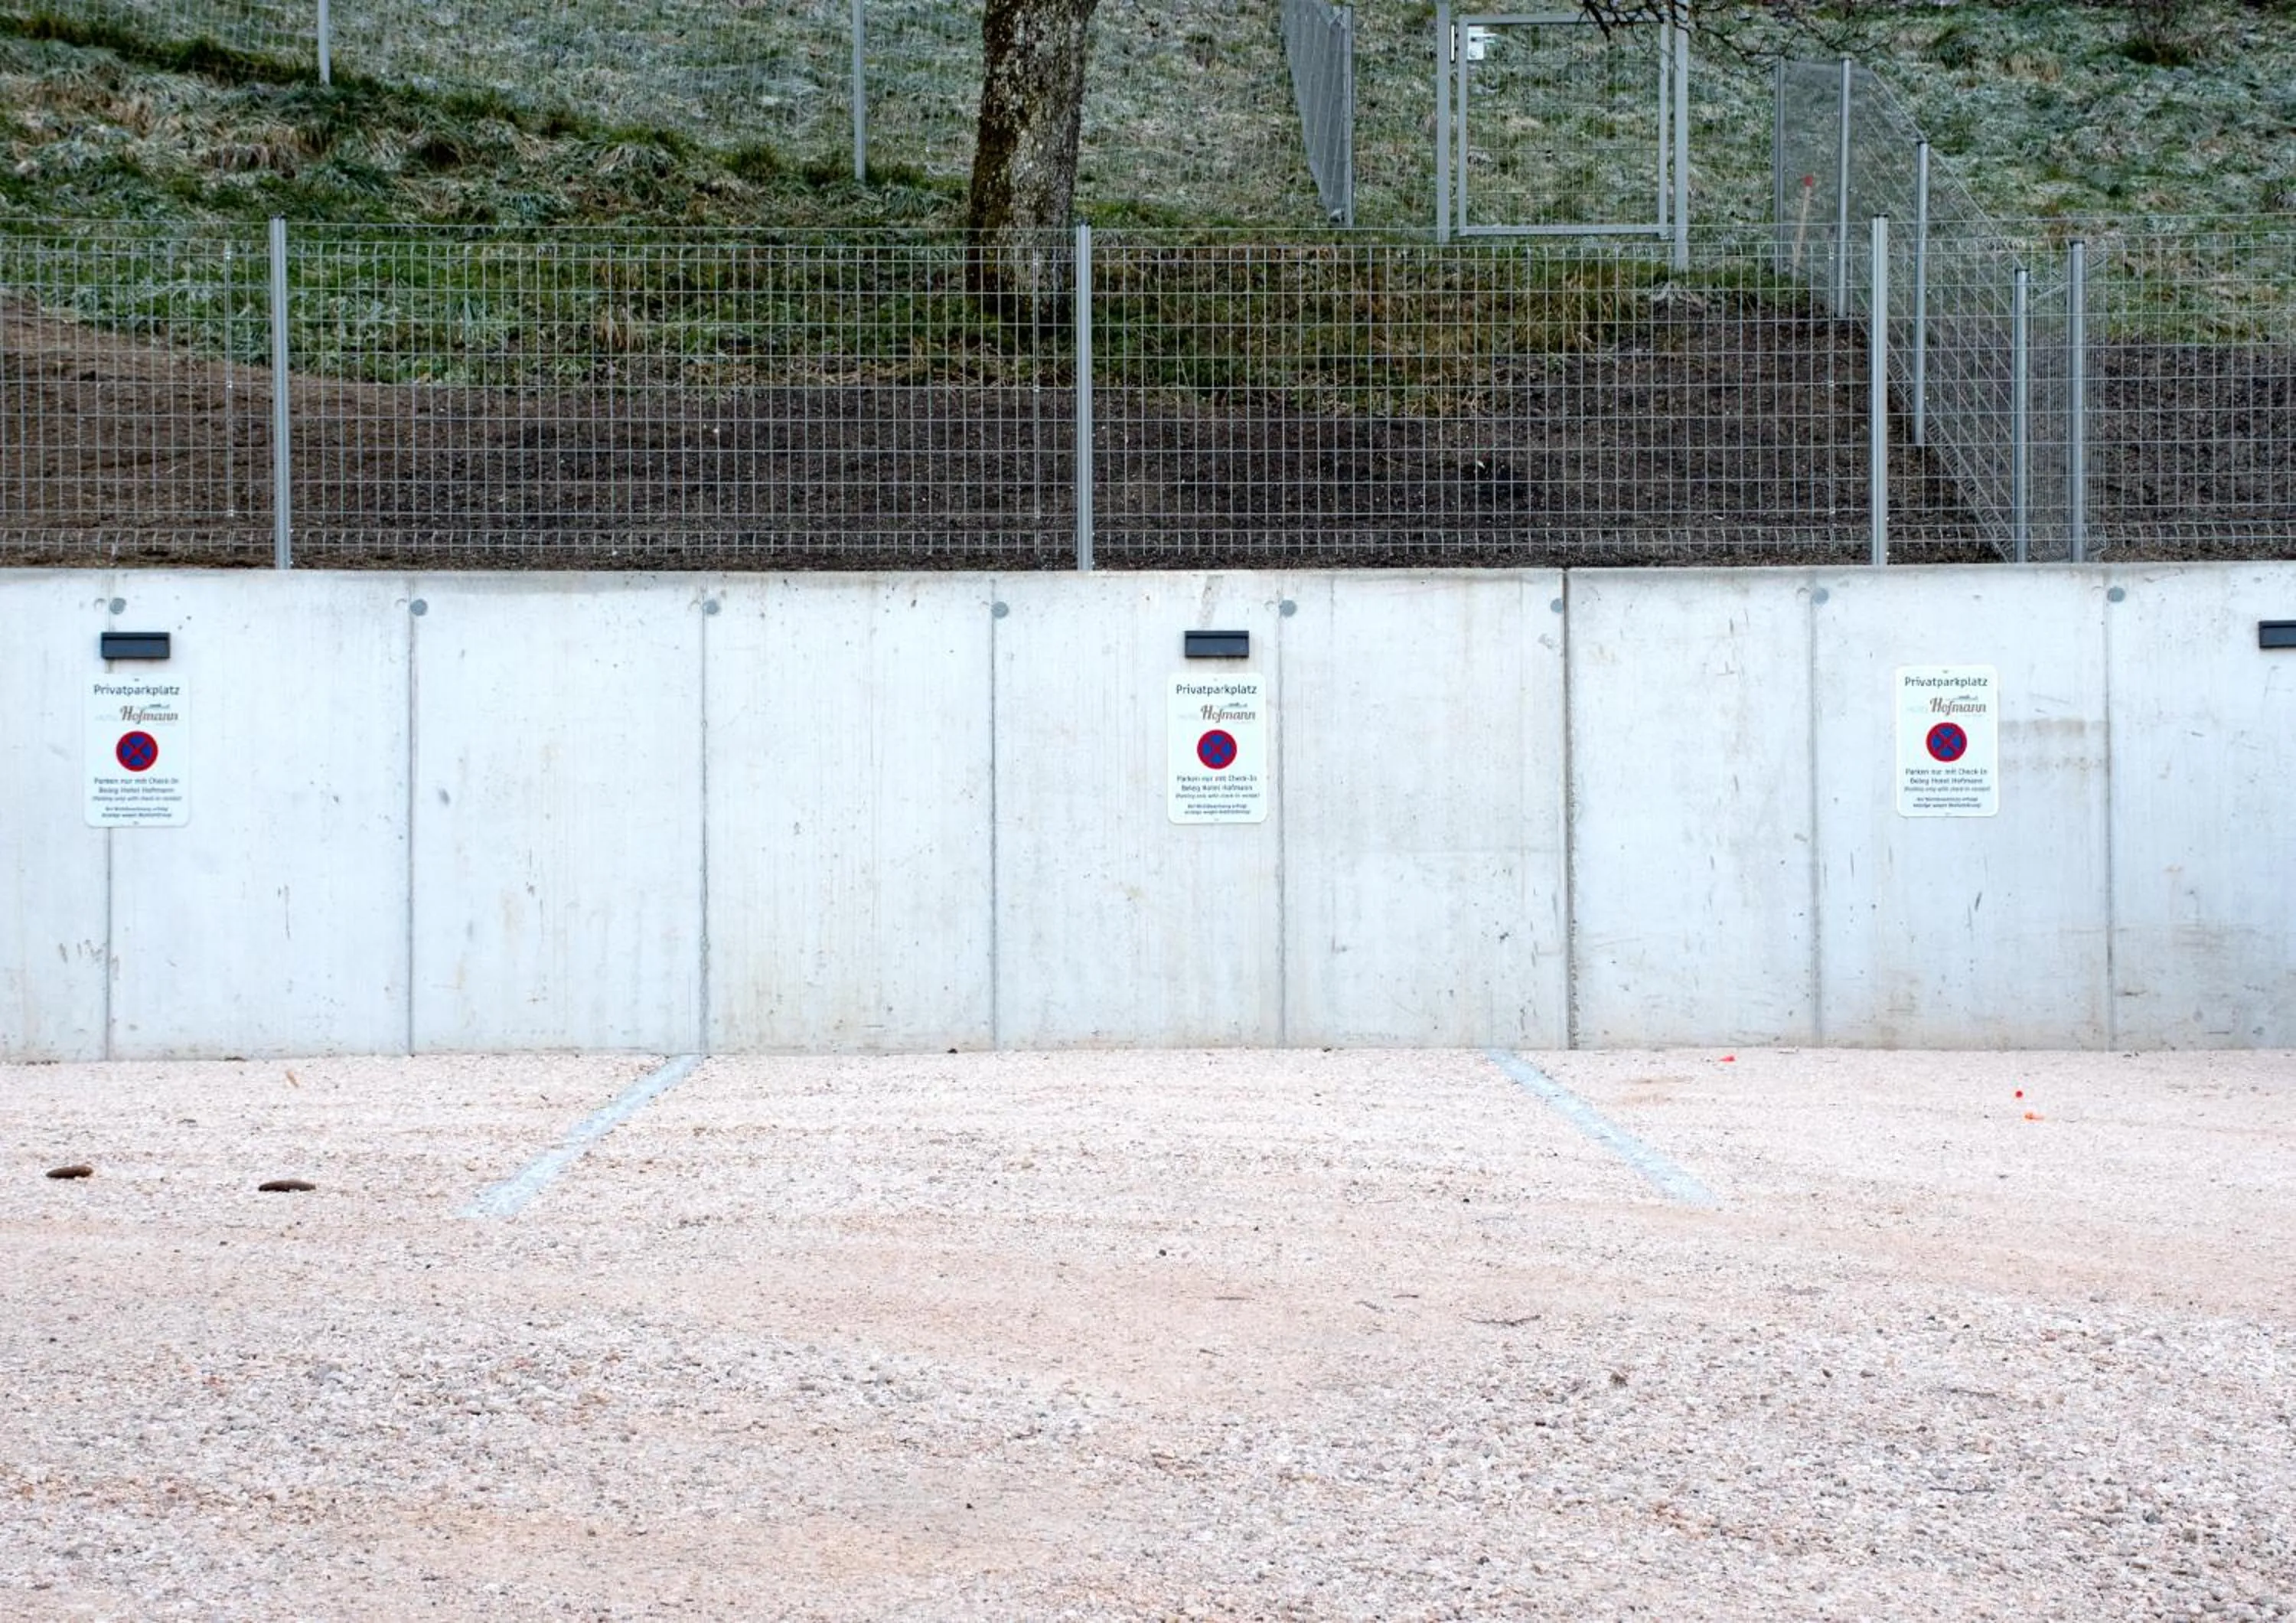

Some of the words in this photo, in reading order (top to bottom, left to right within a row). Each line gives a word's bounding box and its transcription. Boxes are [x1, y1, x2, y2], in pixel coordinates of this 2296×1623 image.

[93, 684, 180, 696] Privatparkplatz
[1176, 684, 1257, 697] Privatparkplatz
[1904, 676, 1988, 689] Privatparkplatz
[120, 704, 179, 724] Hofmann
[1200, 704, 1256, 723] Hofmann
[1929, 696, 1987, 716] Hofmann
